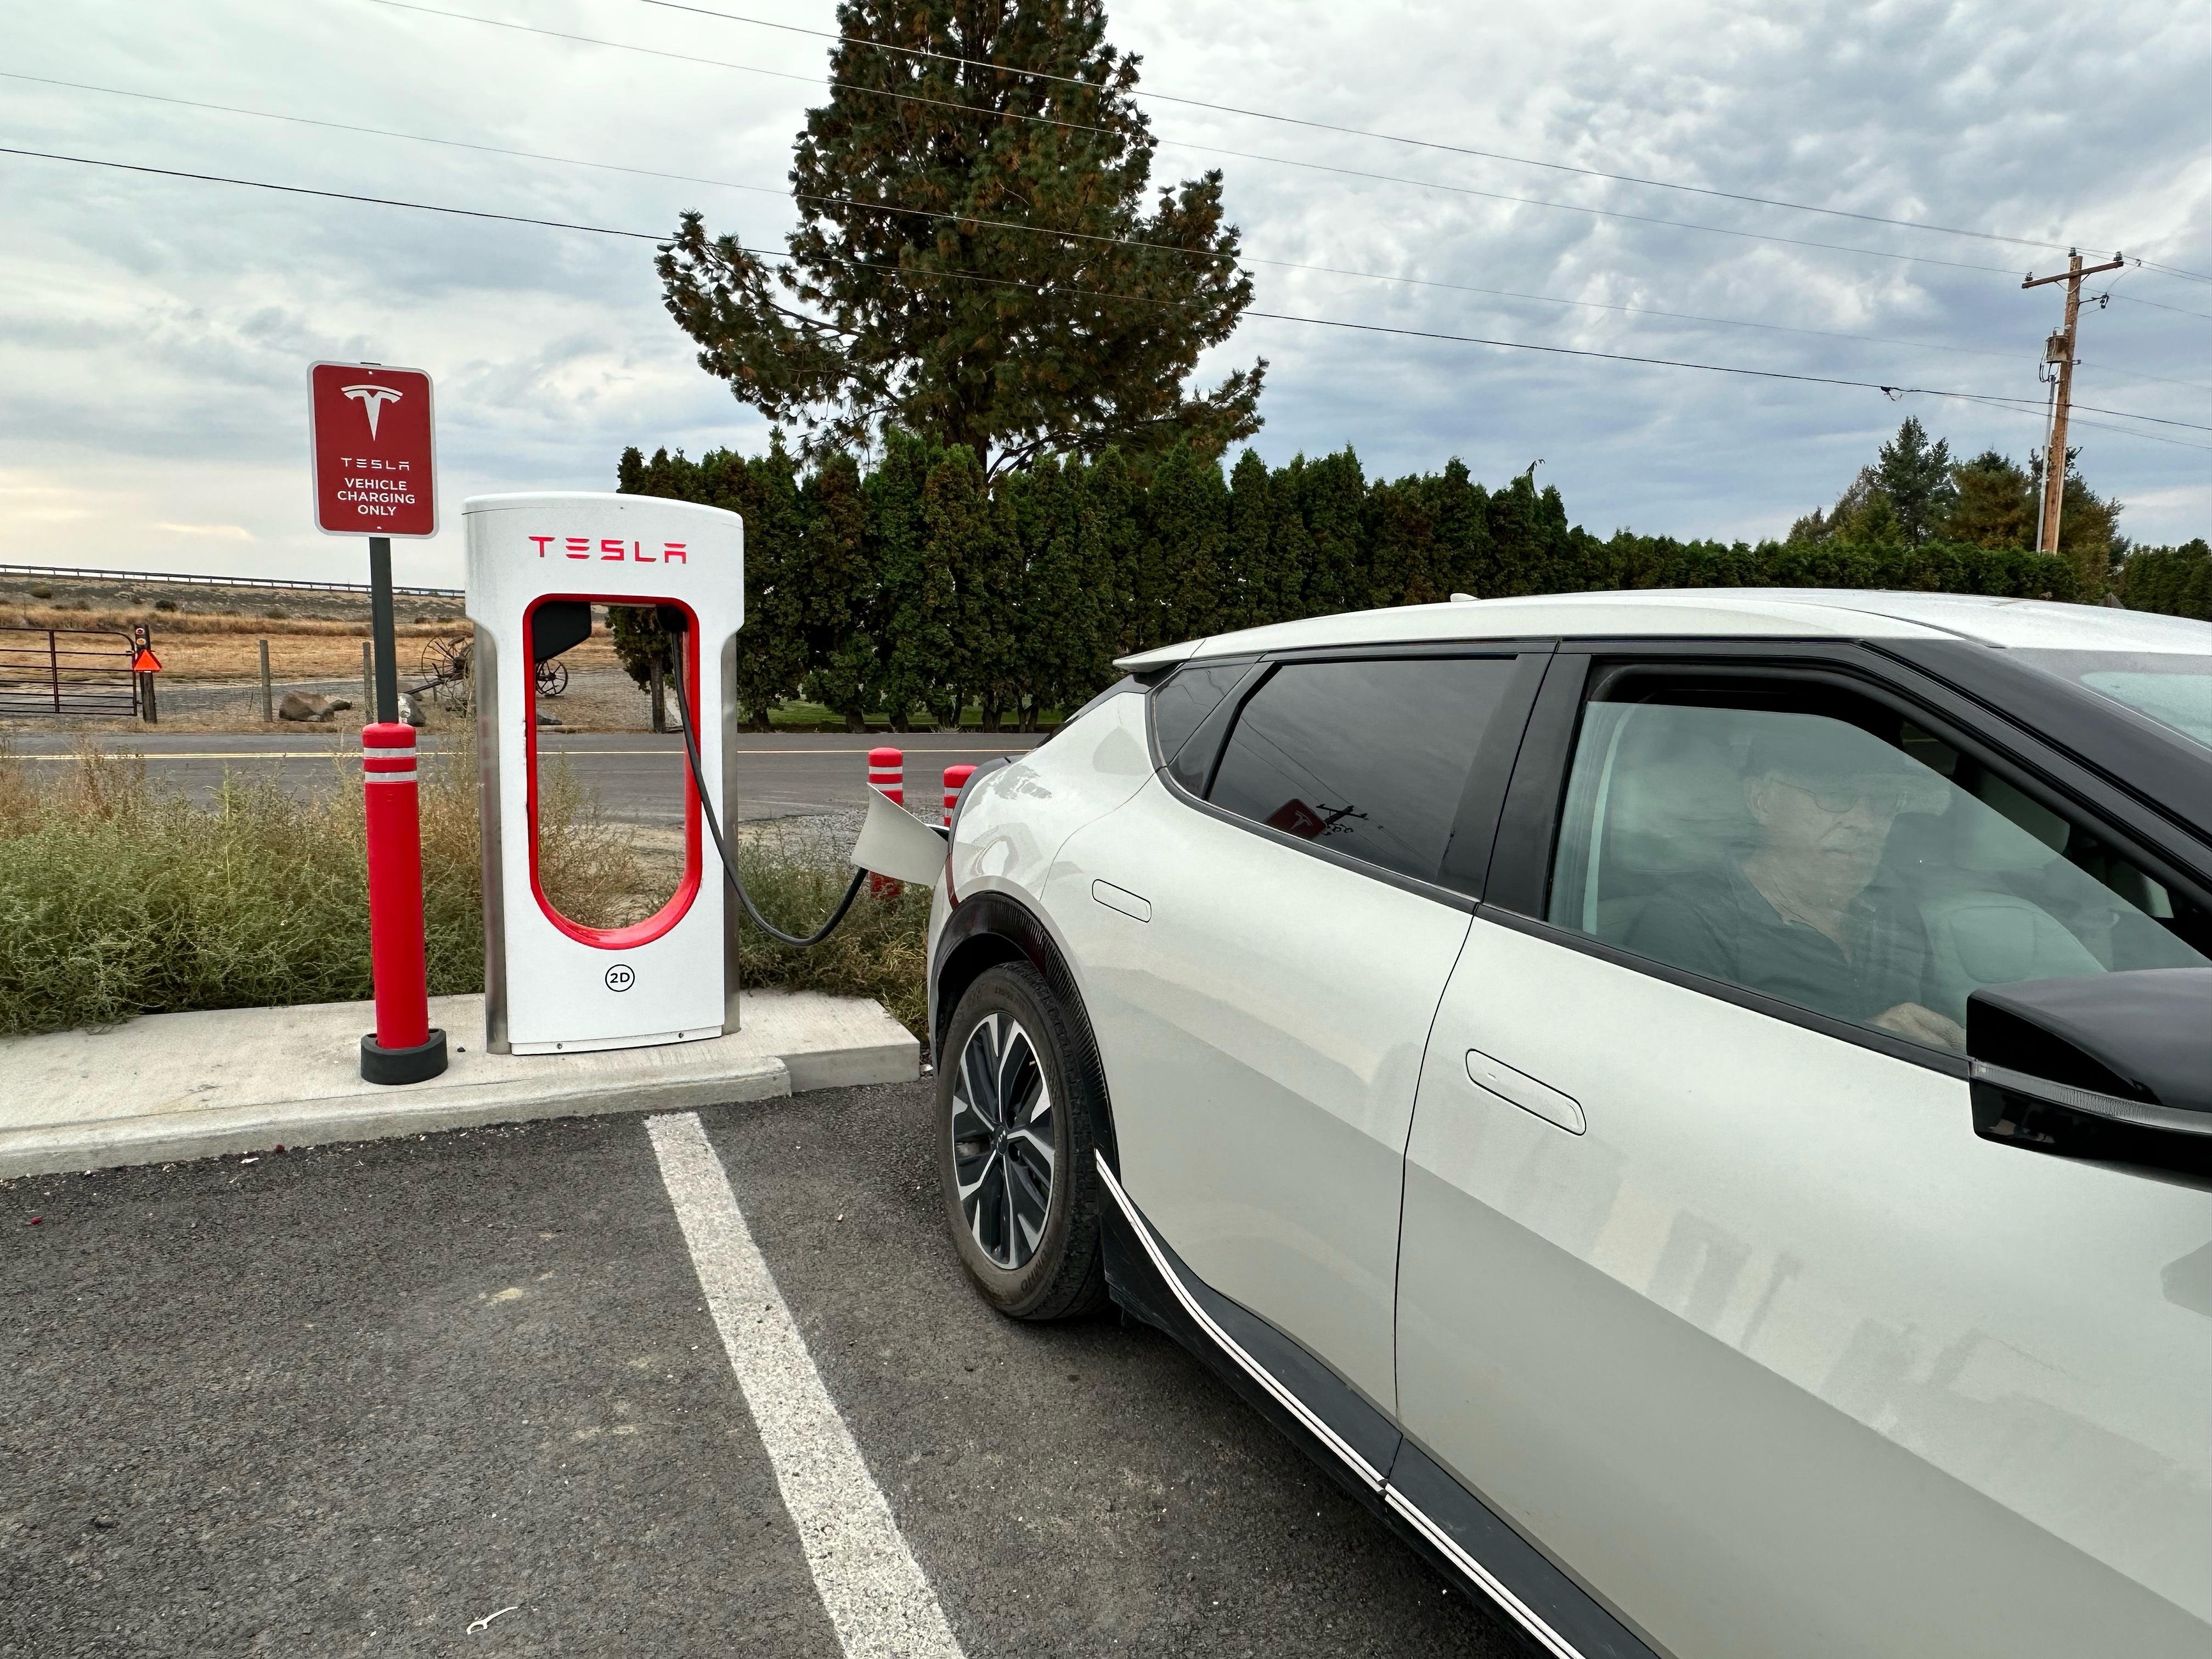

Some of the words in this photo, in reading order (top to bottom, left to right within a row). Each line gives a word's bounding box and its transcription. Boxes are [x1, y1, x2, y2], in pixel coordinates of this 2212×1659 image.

[340, 457, 410, 471] TESLA
[344, 477, 408, 491] VEHICLE
[337, 490, 416, 504] CHARGING
[357, 504, 397, 516] ONLY
[528, 536, 687, 565] TESLA
[610, 972, 630, 984] 2D
